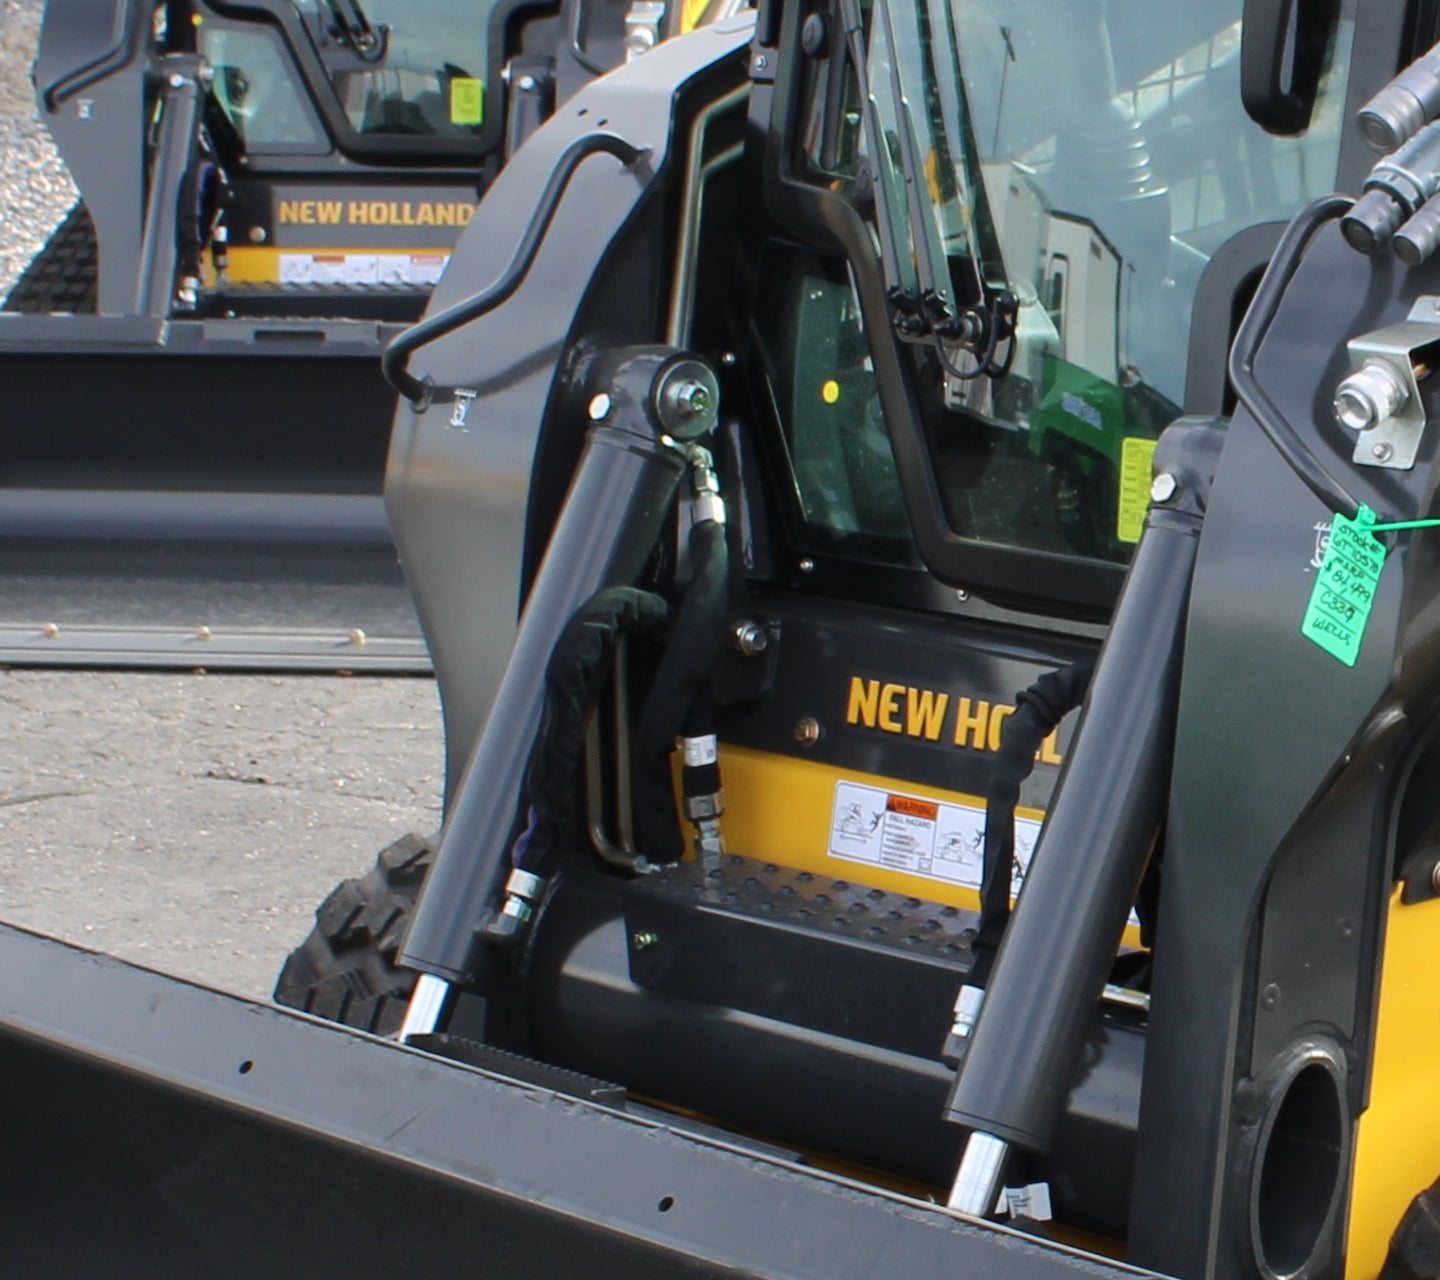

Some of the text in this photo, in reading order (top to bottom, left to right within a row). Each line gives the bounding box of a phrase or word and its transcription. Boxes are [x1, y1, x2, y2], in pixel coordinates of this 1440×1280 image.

[278, 200, 476, 226] NEW HOLLAND
[846, 675, 949, 742] NEW
